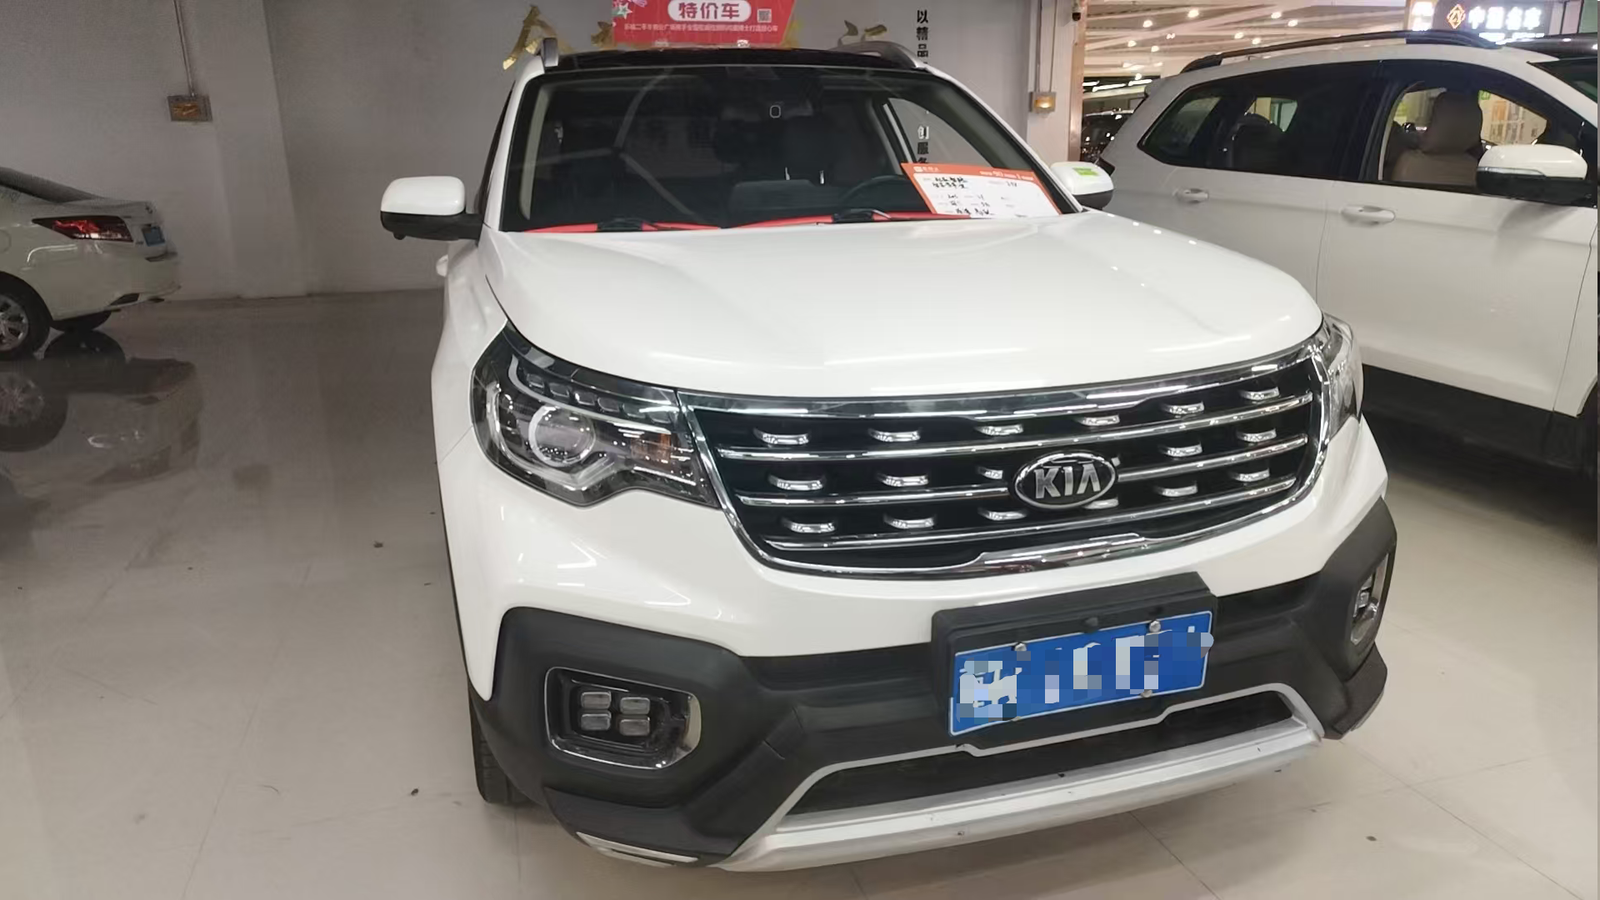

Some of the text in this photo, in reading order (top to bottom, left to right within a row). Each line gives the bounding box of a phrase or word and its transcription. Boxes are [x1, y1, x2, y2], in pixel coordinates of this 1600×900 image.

[678, 2, 740, 19] 特价车
[916, 9, 929, 58] 以精品
[1034, 463, 1101, 499] KIA
